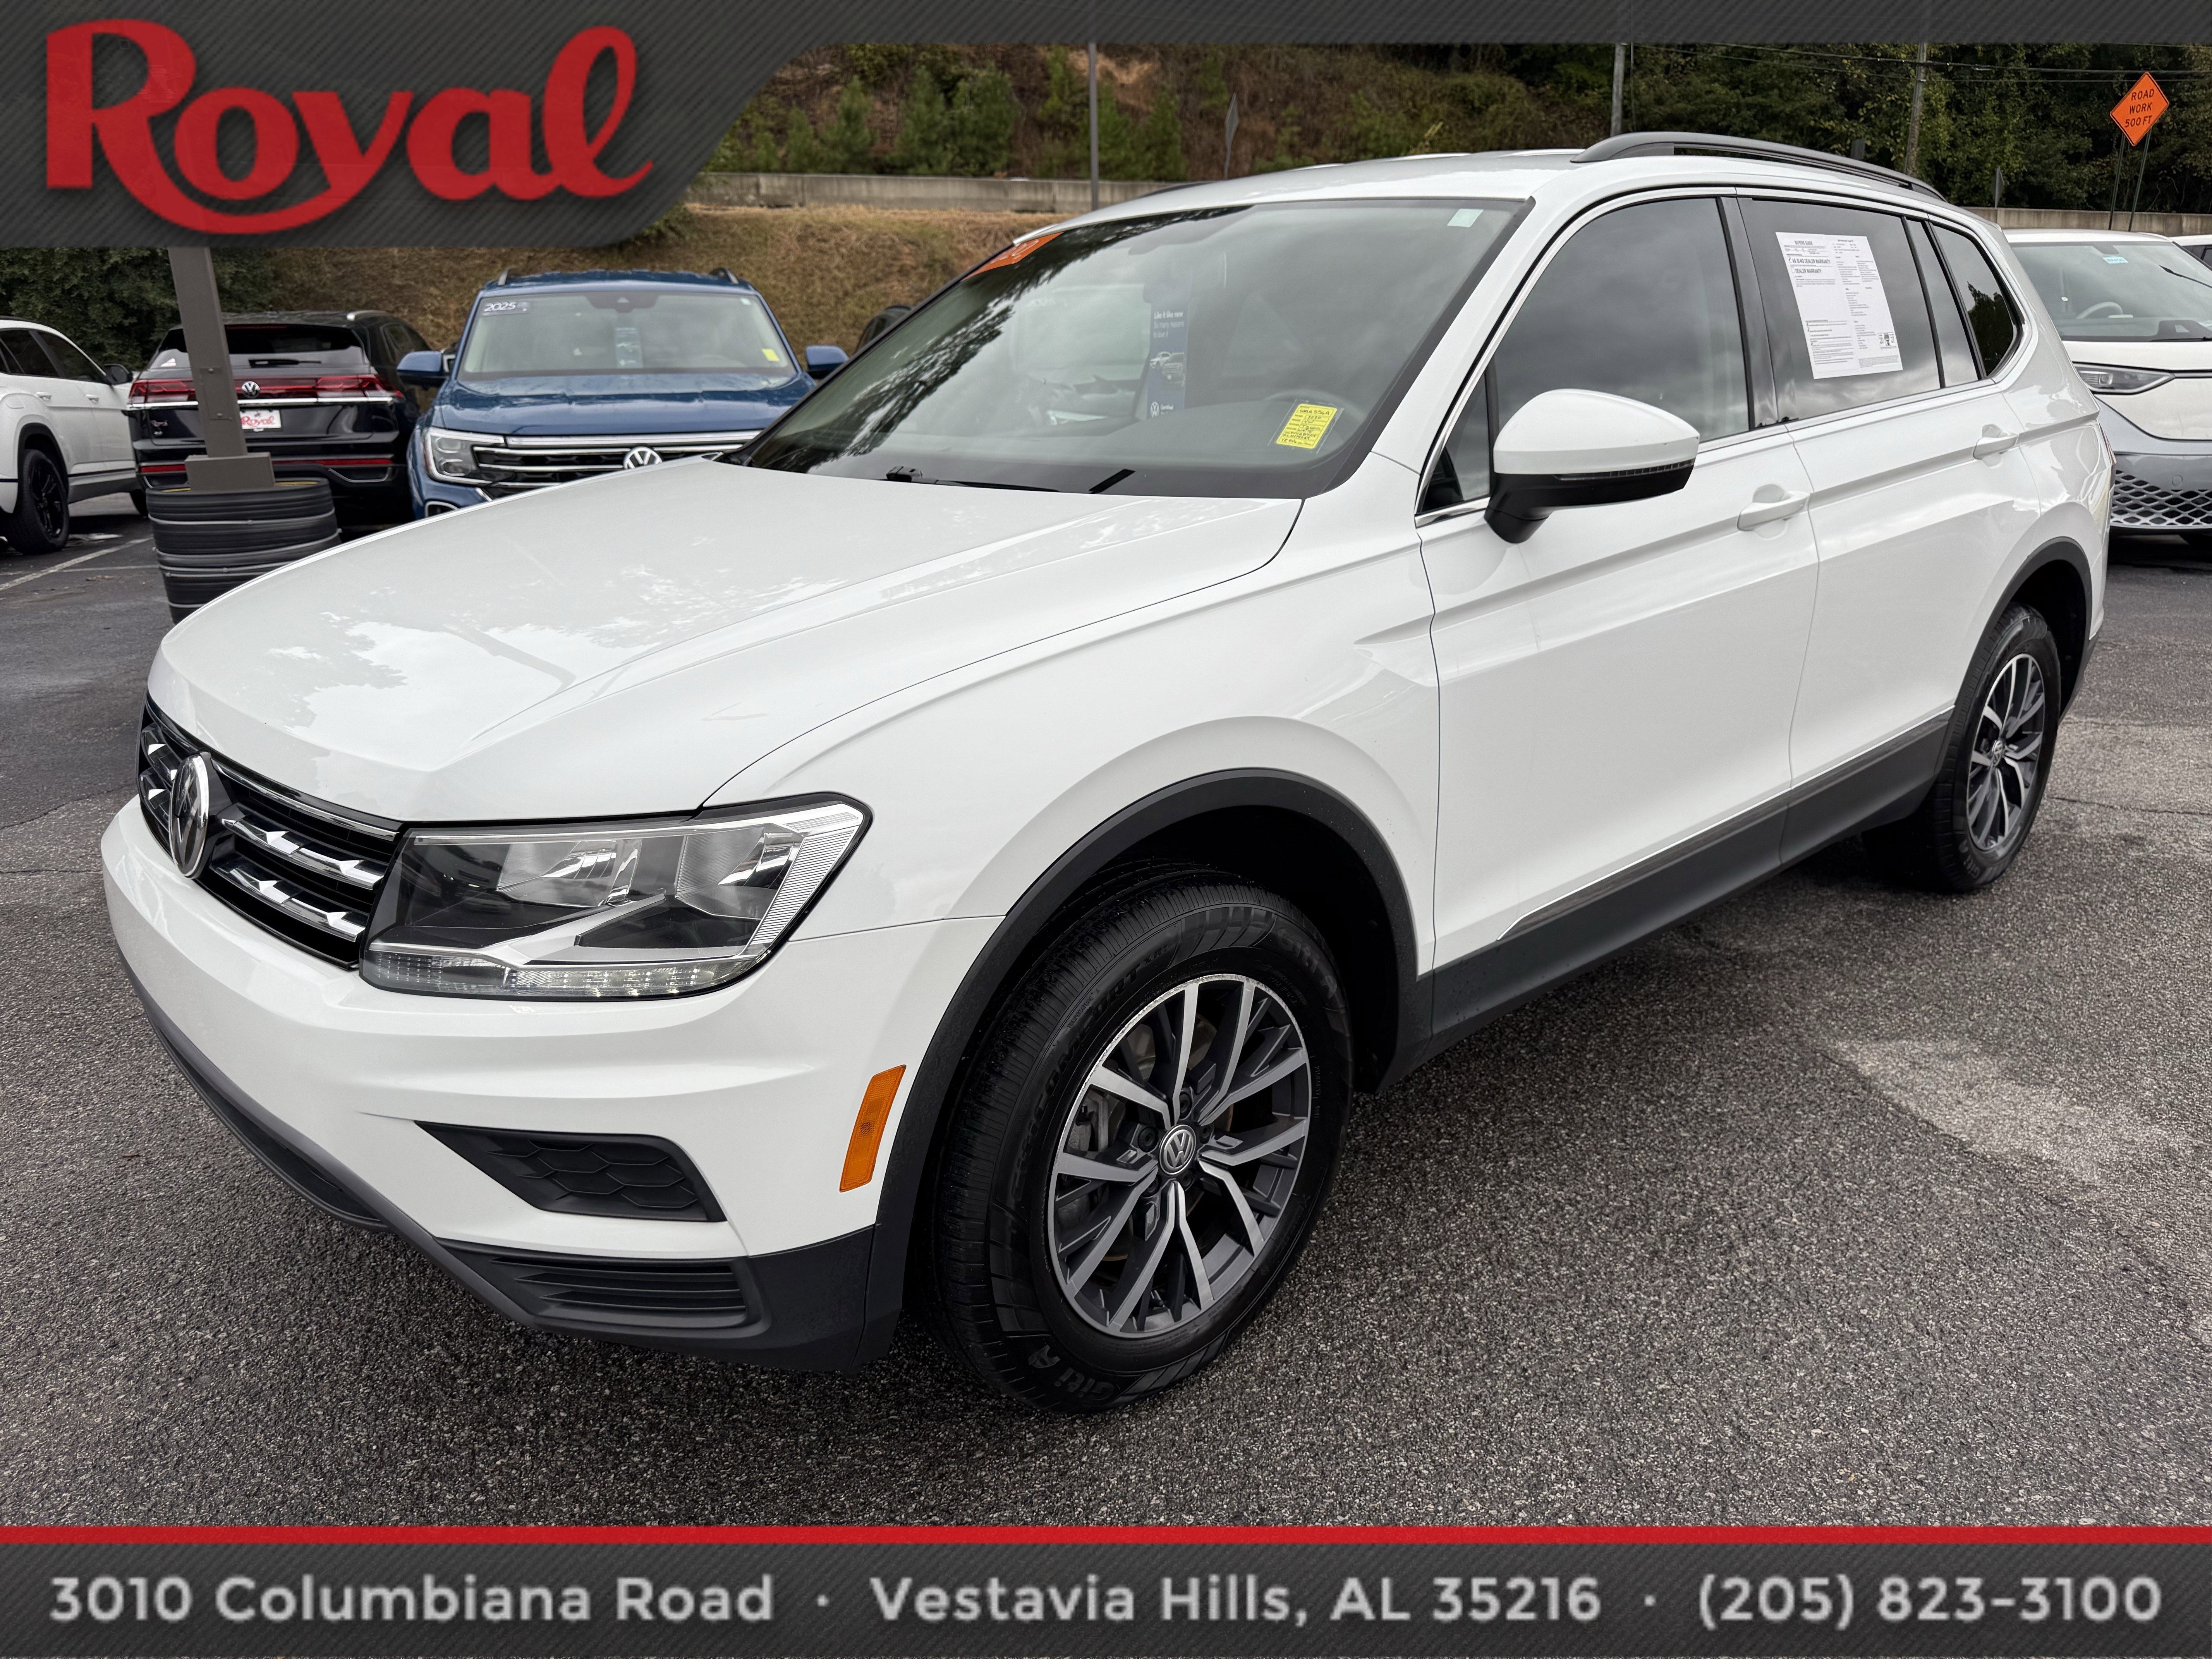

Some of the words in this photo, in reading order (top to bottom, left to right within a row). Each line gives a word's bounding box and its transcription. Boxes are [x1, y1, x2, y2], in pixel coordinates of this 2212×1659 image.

[2131, 89, 2154, 101] ROAD
[2130, 103, 2152, 114] WORK
[2124, 118, 2141, 128] 500
[2143, 115, 2152, 125] FT
[484, 302, 516, 312] 2025
